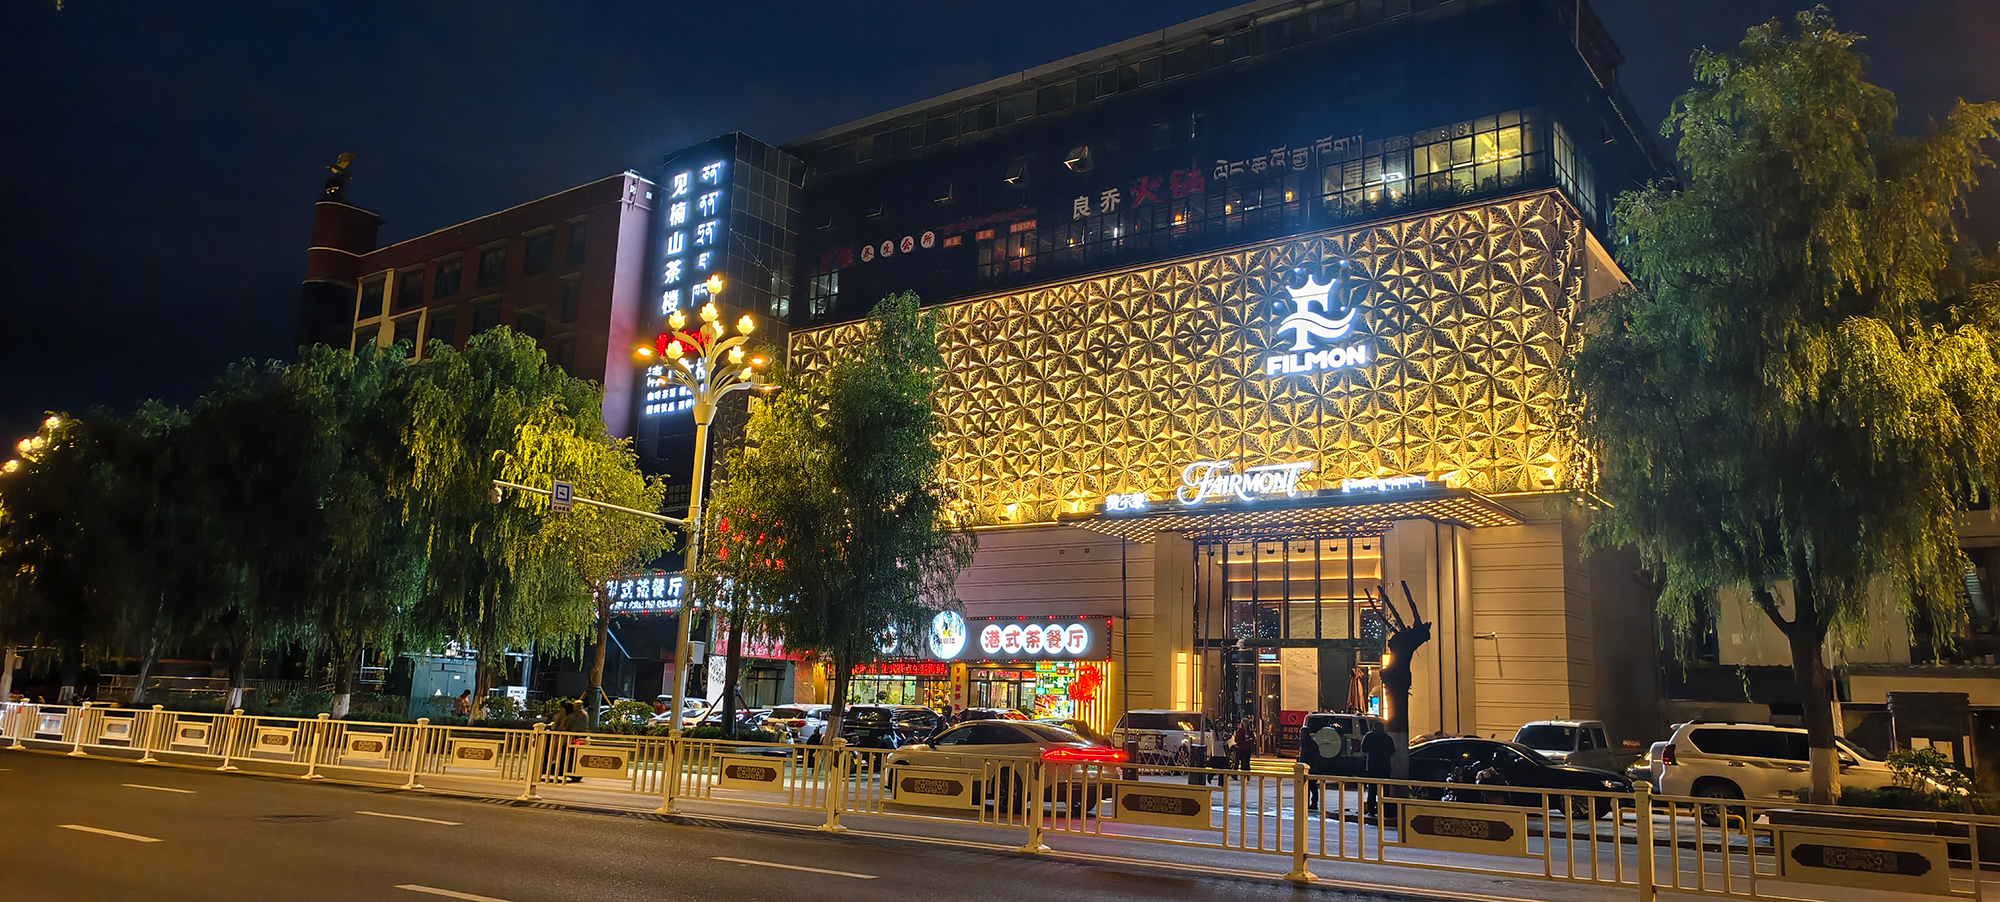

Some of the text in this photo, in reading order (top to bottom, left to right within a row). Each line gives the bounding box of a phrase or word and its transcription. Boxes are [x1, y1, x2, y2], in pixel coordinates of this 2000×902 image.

[1267, 345, 1367, 376] FILMON
[1106, 492, 1147, 511] 费尔蒙
[984, 629, 1084, 649] 港式茶餐厅
